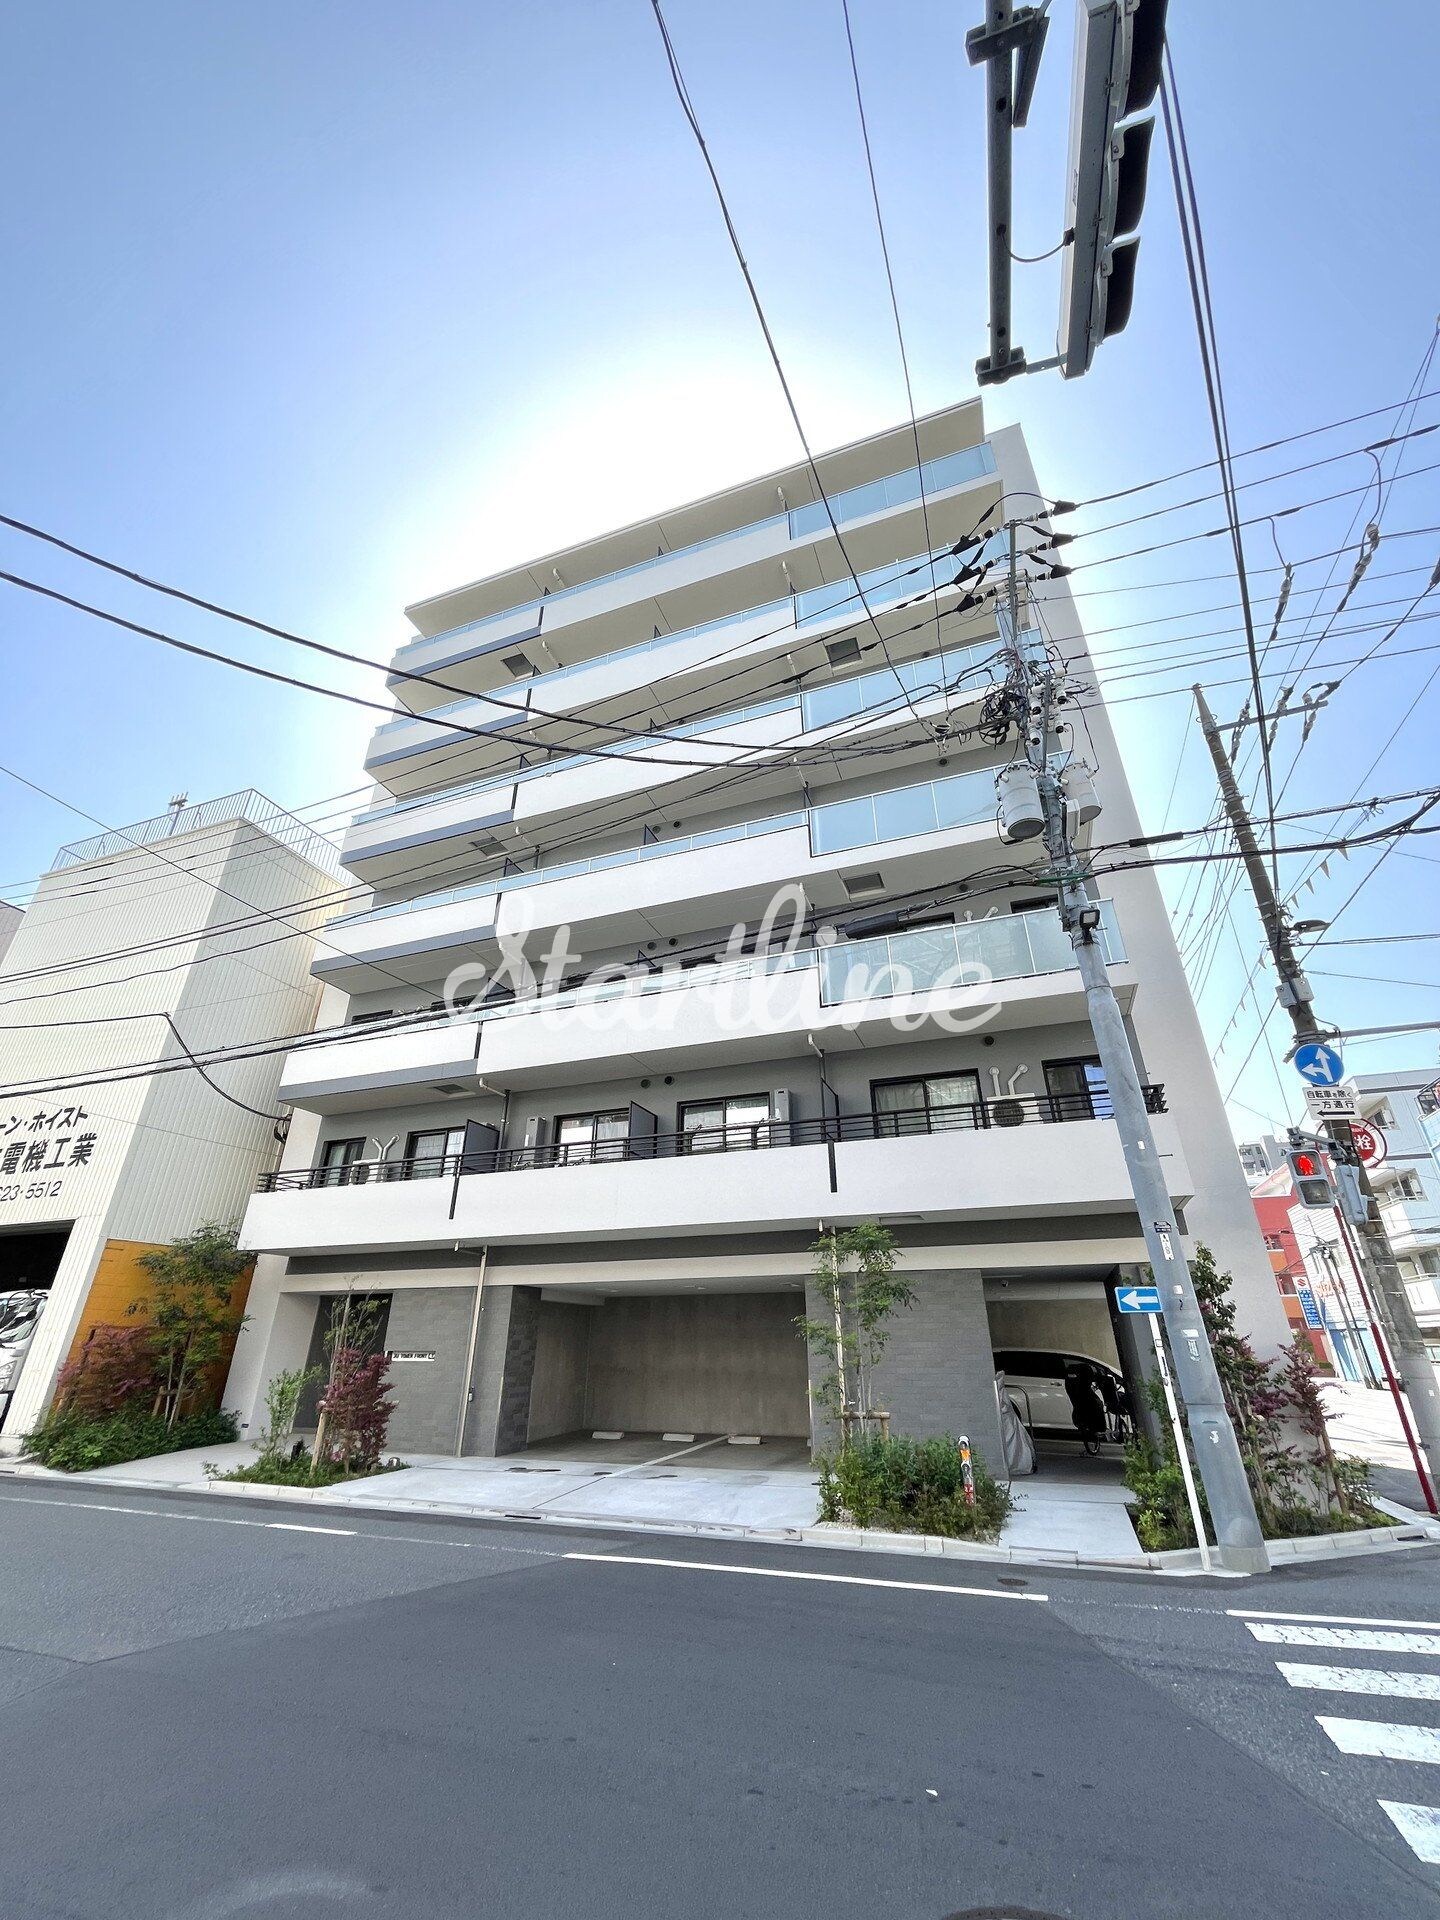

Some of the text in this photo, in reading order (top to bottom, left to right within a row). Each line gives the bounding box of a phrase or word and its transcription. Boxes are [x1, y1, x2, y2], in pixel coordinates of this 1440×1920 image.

[1306, 1090, 1352, 1098] 自転車を除く
[1310, 1100, 1355, 1109] 一方通行
[0, 1132, 97, 1175] 電機工業
